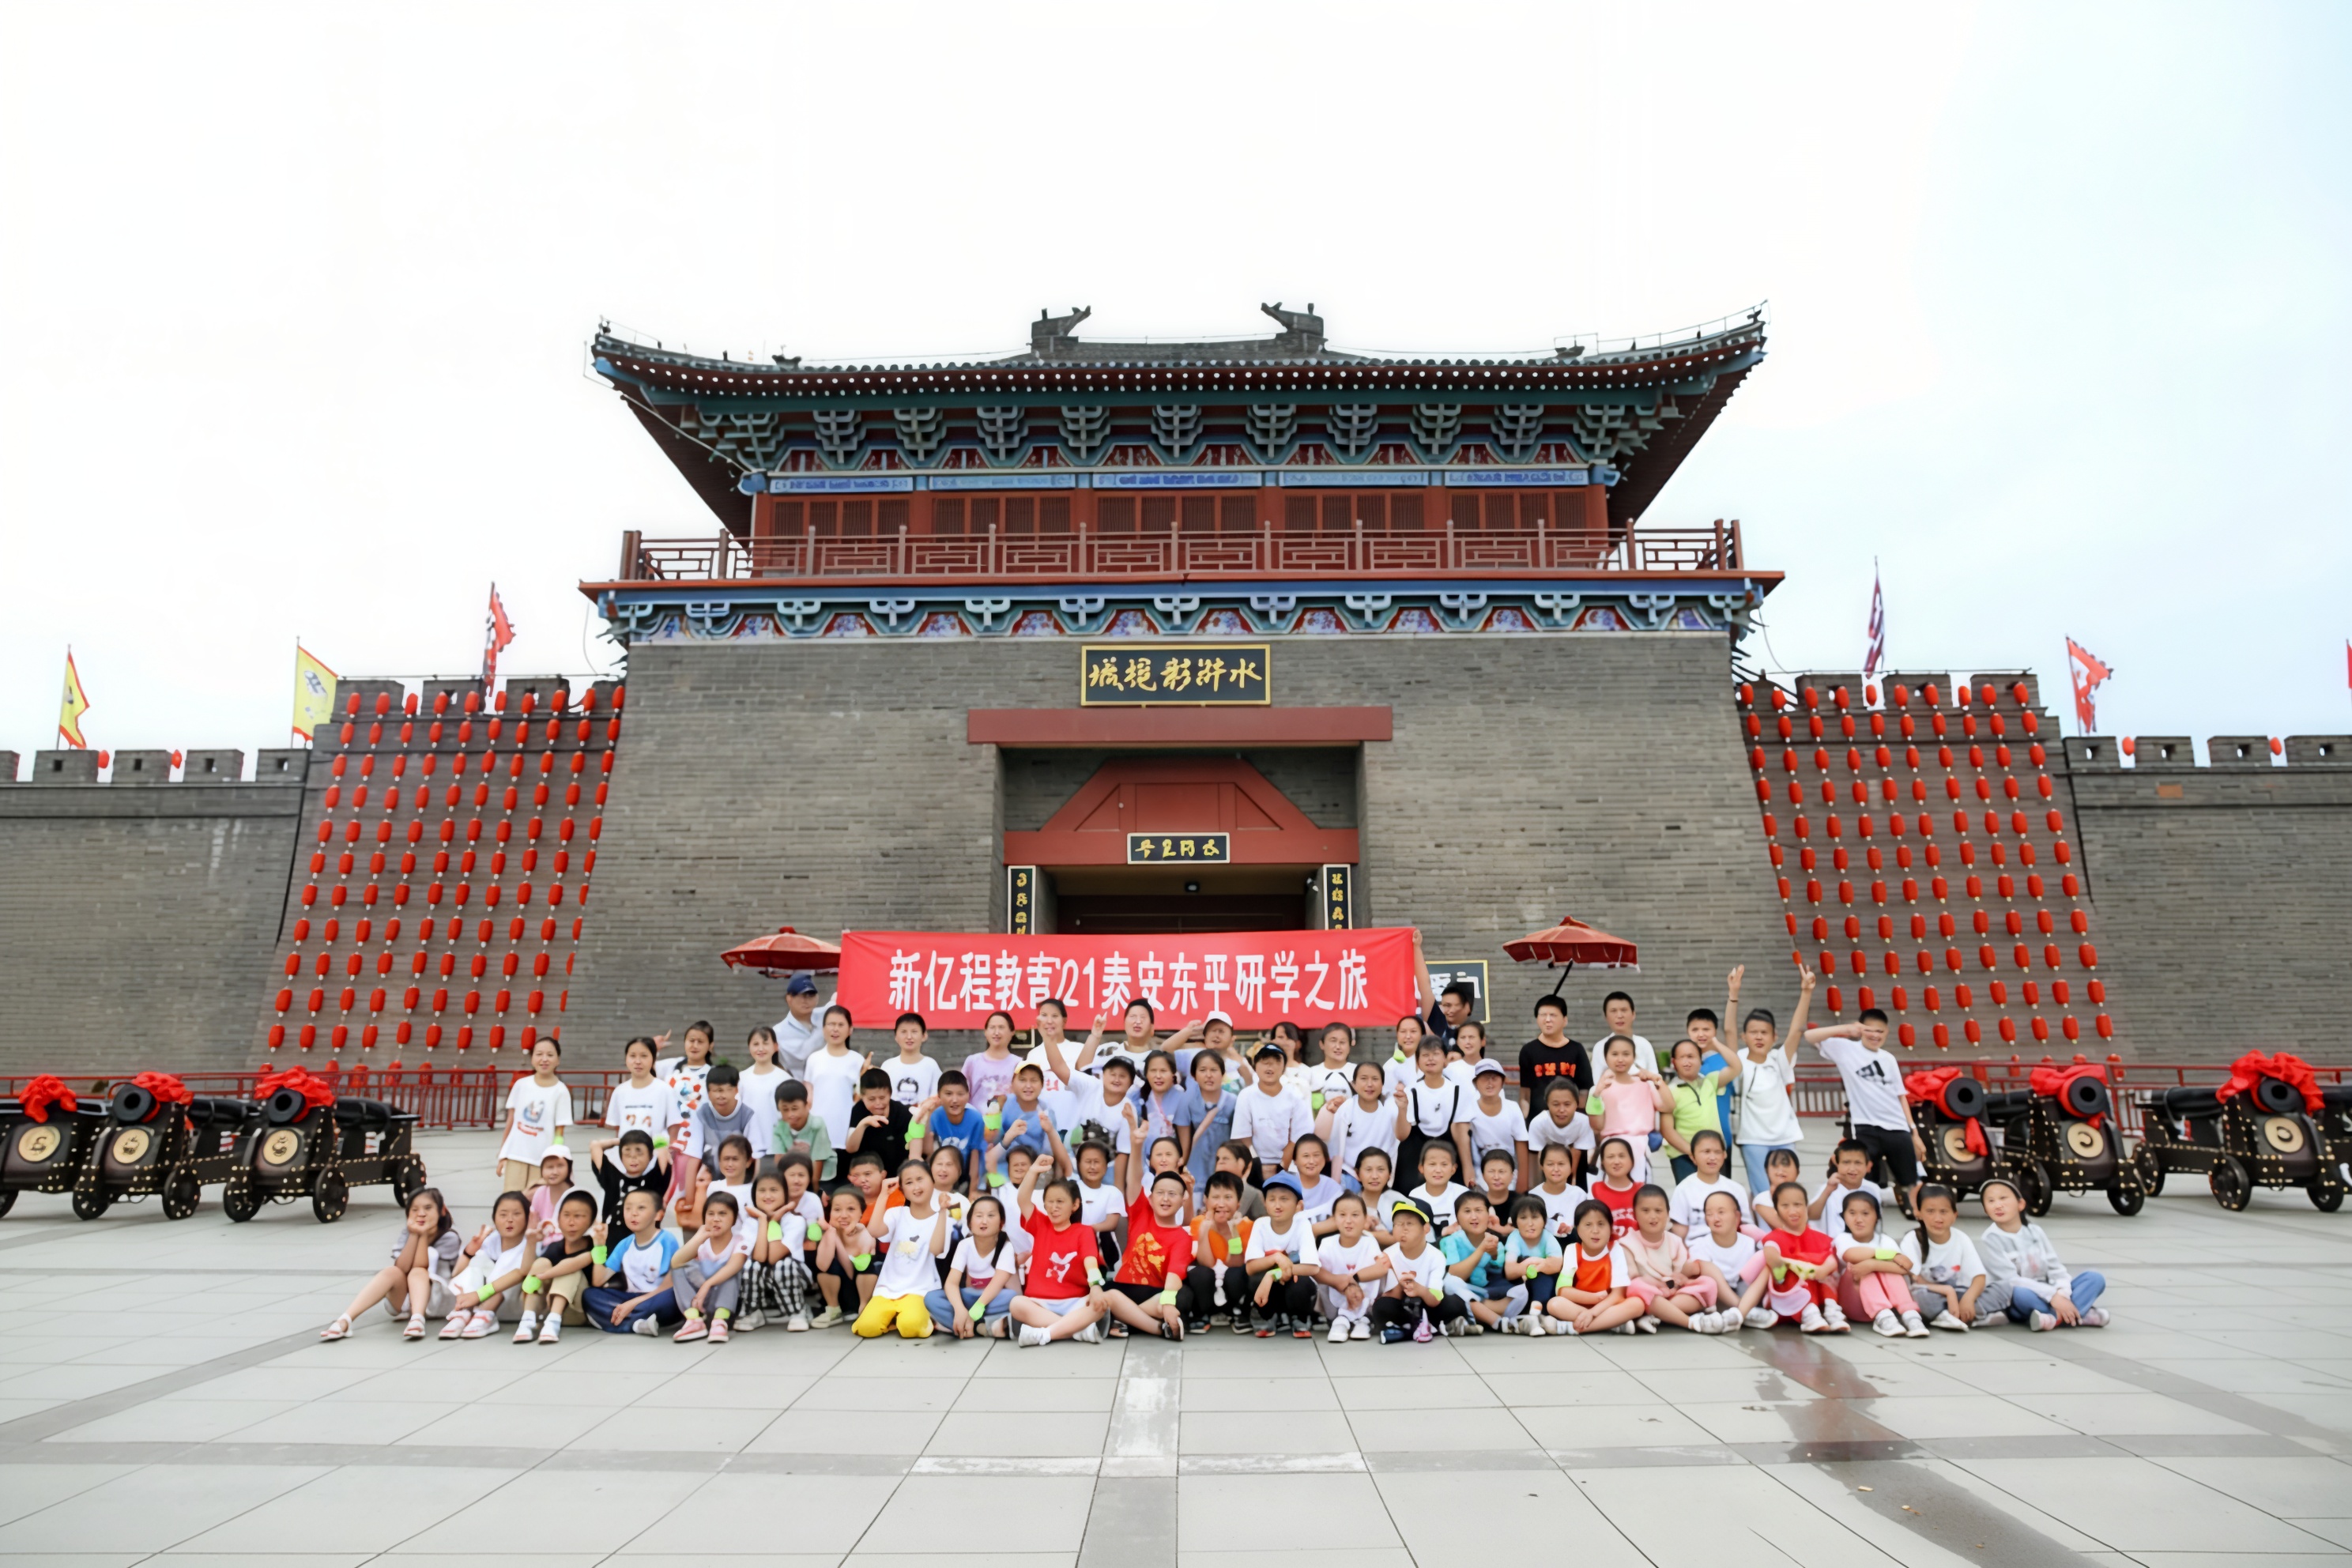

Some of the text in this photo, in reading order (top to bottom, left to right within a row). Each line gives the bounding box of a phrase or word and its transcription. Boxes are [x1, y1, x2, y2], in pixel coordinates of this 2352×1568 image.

[888, 948, 1369, 1016] 新亿程教育21泰安东平研学之旅
